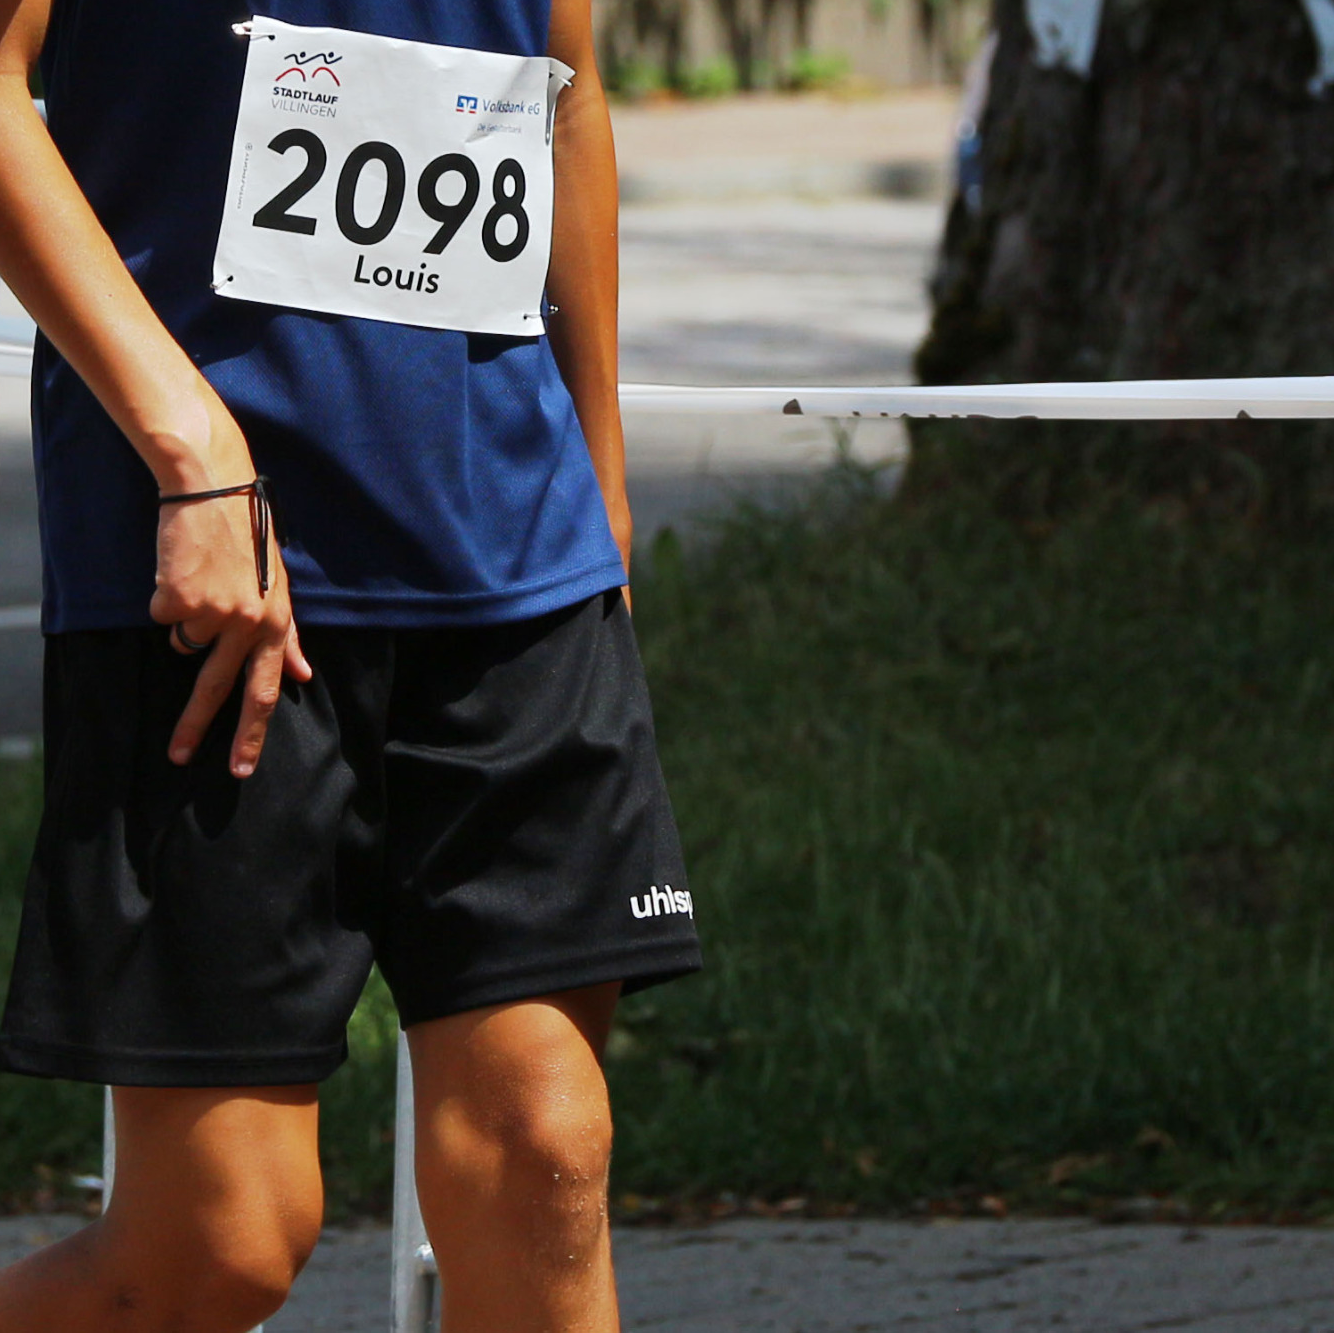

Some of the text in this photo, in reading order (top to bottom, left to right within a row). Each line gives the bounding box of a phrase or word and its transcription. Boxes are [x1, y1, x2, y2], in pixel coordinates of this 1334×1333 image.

[273, 86, 339, 105] STADTLAUF
[271, 98, 337, 118] VILLINGEN
[482, 99, 541, 115] Volksbank eG
[252, 128, 530, 263] 2098
[353, 254, 440, 294] Louis
